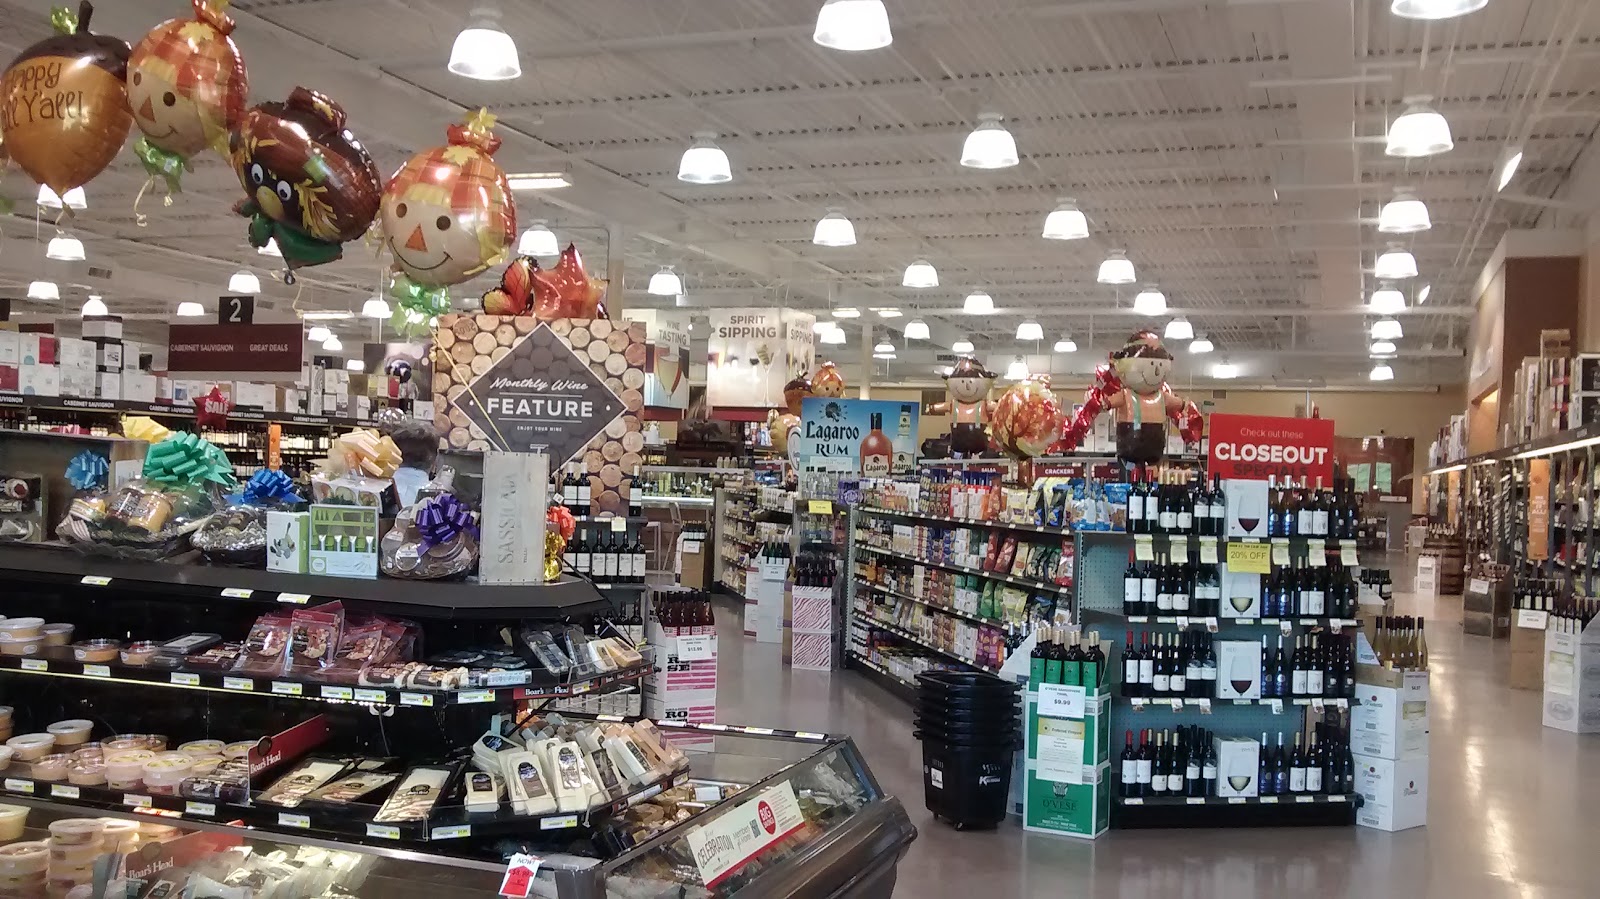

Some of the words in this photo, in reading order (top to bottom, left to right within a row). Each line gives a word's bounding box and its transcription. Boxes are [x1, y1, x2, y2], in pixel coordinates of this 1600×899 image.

[229, 298, 241, 322] 2
[730, 315, 766, 325] SPIRIT
[658, 329, 687, 346] TASTING
[719, 327, 777, 339] SIPPING
[170, 344, 199, 352] CABERNET
[200, 344, 234, 353] SAUVIGNON
[249, 344, 268, 353] GREAT
[269, 344, 288, 353] DEALS
[489, 376, 549, 392] Monthly
[551, 379, 589, 391] Wine
[63, 400, 88, 408] CABERNET
[88, 401, 115, 409] SAUVIGNON
[205, 399, 228, 415] SALE
[487, 397, 593, 418] FEATURE
[805, 421, 860, 442] Lagaroo
[1240, 427, 1266, 437] Check
[1267, 429, 1281, 438] out
[1282, 430, 1304, 439] these
[815, 443, 849, 457] RUM
[1214, 442, 1328, 465] CLOSEOUT
[1230, 551, 1248, 560] 20%
[1249, 551, 1266, 560] OFF
[525, 687, 544, 696] Boar's
[250, 755, 267, 775] Boar's
[266, 750, 281, 766] Head
[759, 806, 772, 821] BIG
[697, 834, 735, 869] CELEBRATION
[128, 862, 152, 879] Boar's
[153, 857, 174, 873] Head
